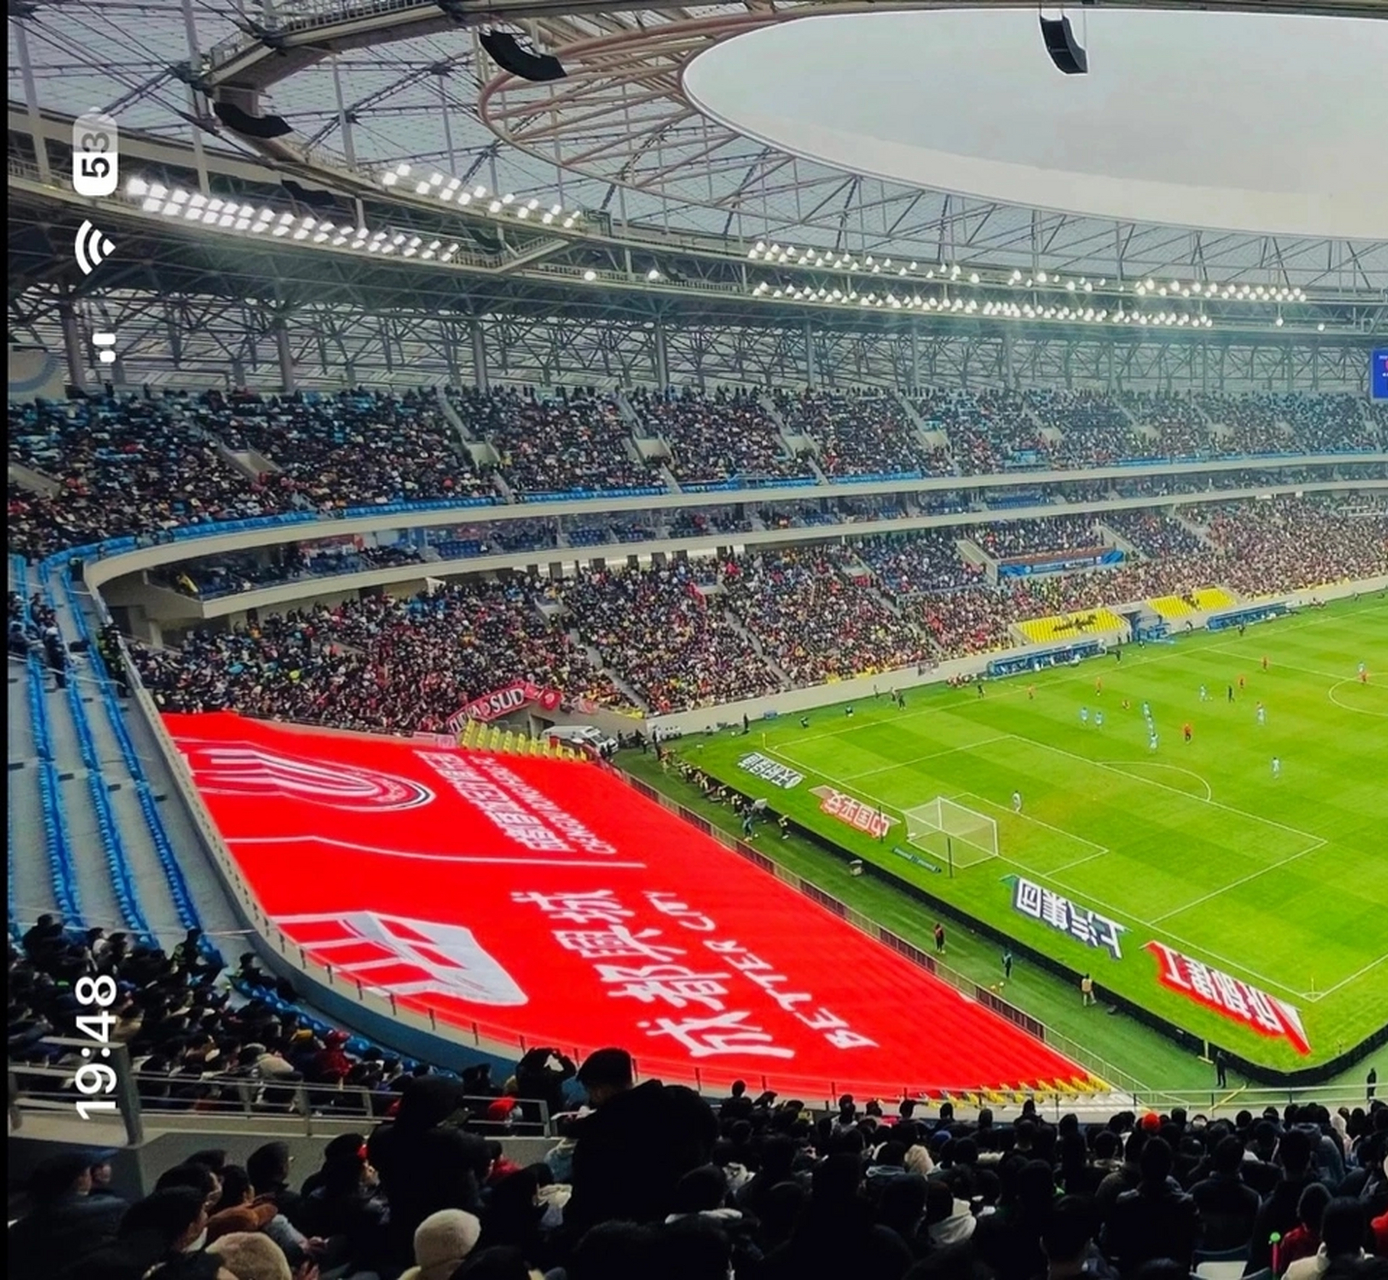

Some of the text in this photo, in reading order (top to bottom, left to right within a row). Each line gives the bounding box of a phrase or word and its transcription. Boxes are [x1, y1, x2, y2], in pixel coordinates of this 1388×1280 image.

[490, 688, 525, 714] SUD
[1015, 877, 1127, 960] 上汽集团
[641, 890, 880, 1049] BETTER CITY
